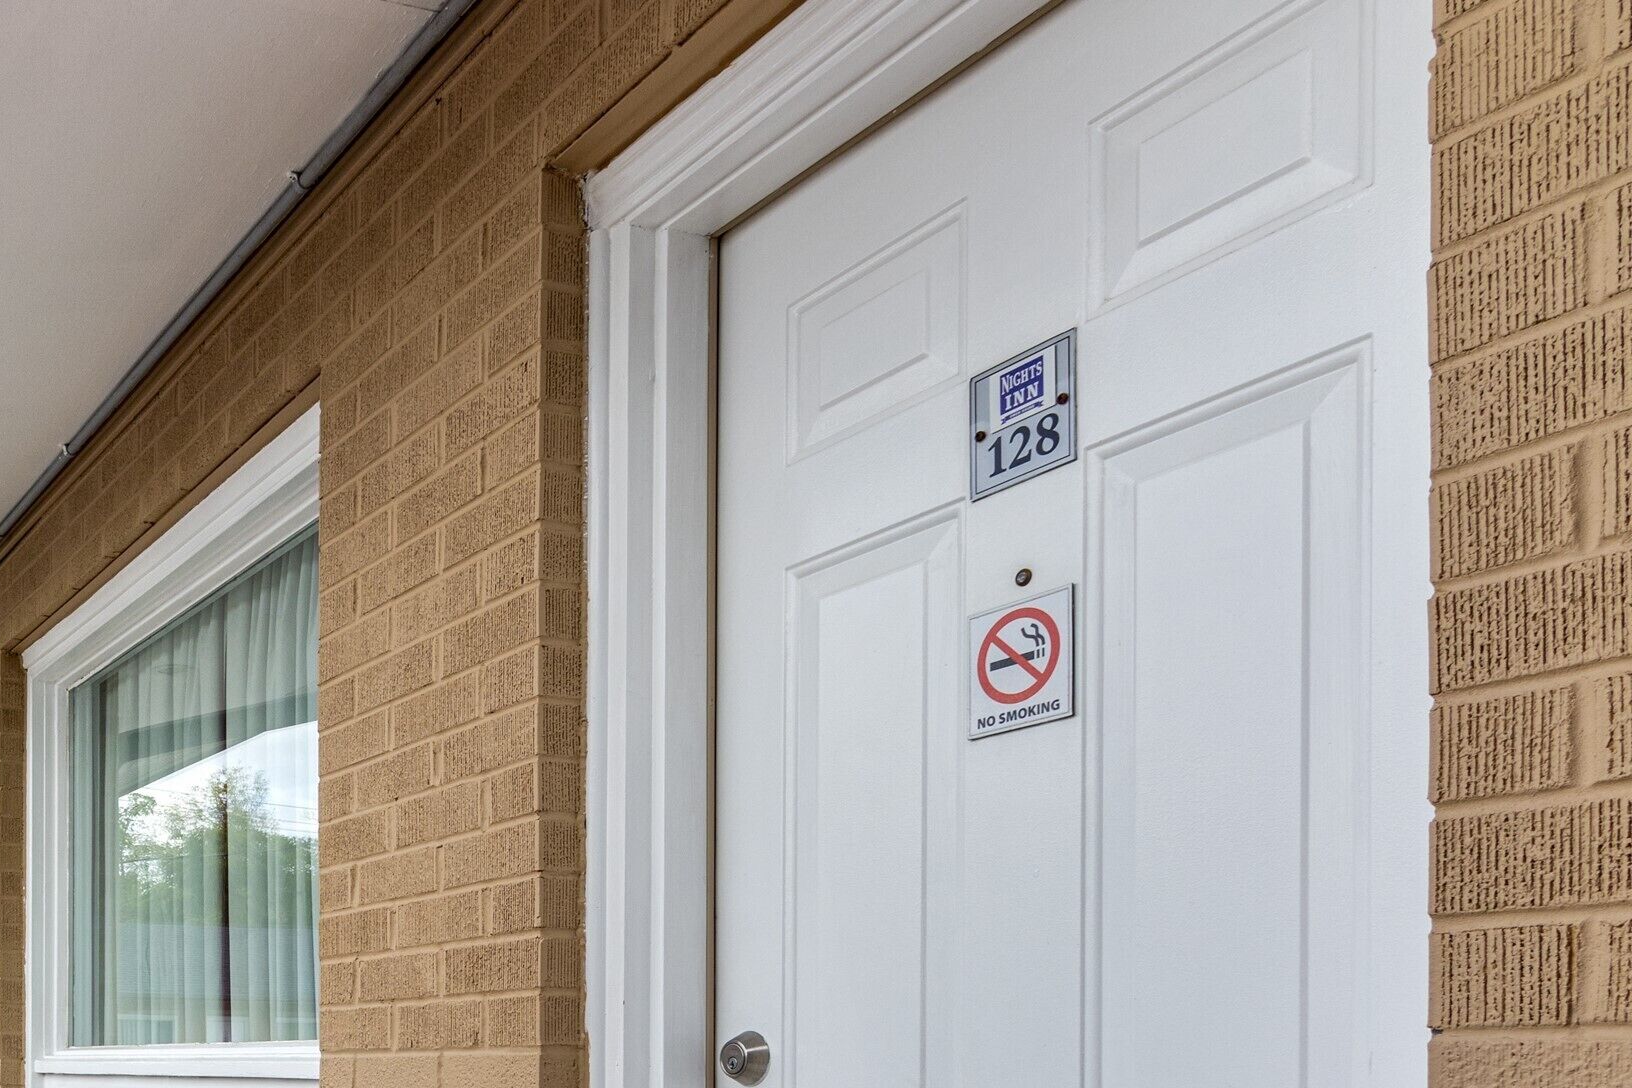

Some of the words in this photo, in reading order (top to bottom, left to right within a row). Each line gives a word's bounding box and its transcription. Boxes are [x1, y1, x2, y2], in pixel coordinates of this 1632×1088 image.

[1001, 361, 1043, 395] NIGHTS
[1005, 381, 1039, 411] INN
[988, 413, 1060, 478] 128
[977, 716, 996, 730] NO
[999, 699, 1060, 724] SMOKING
